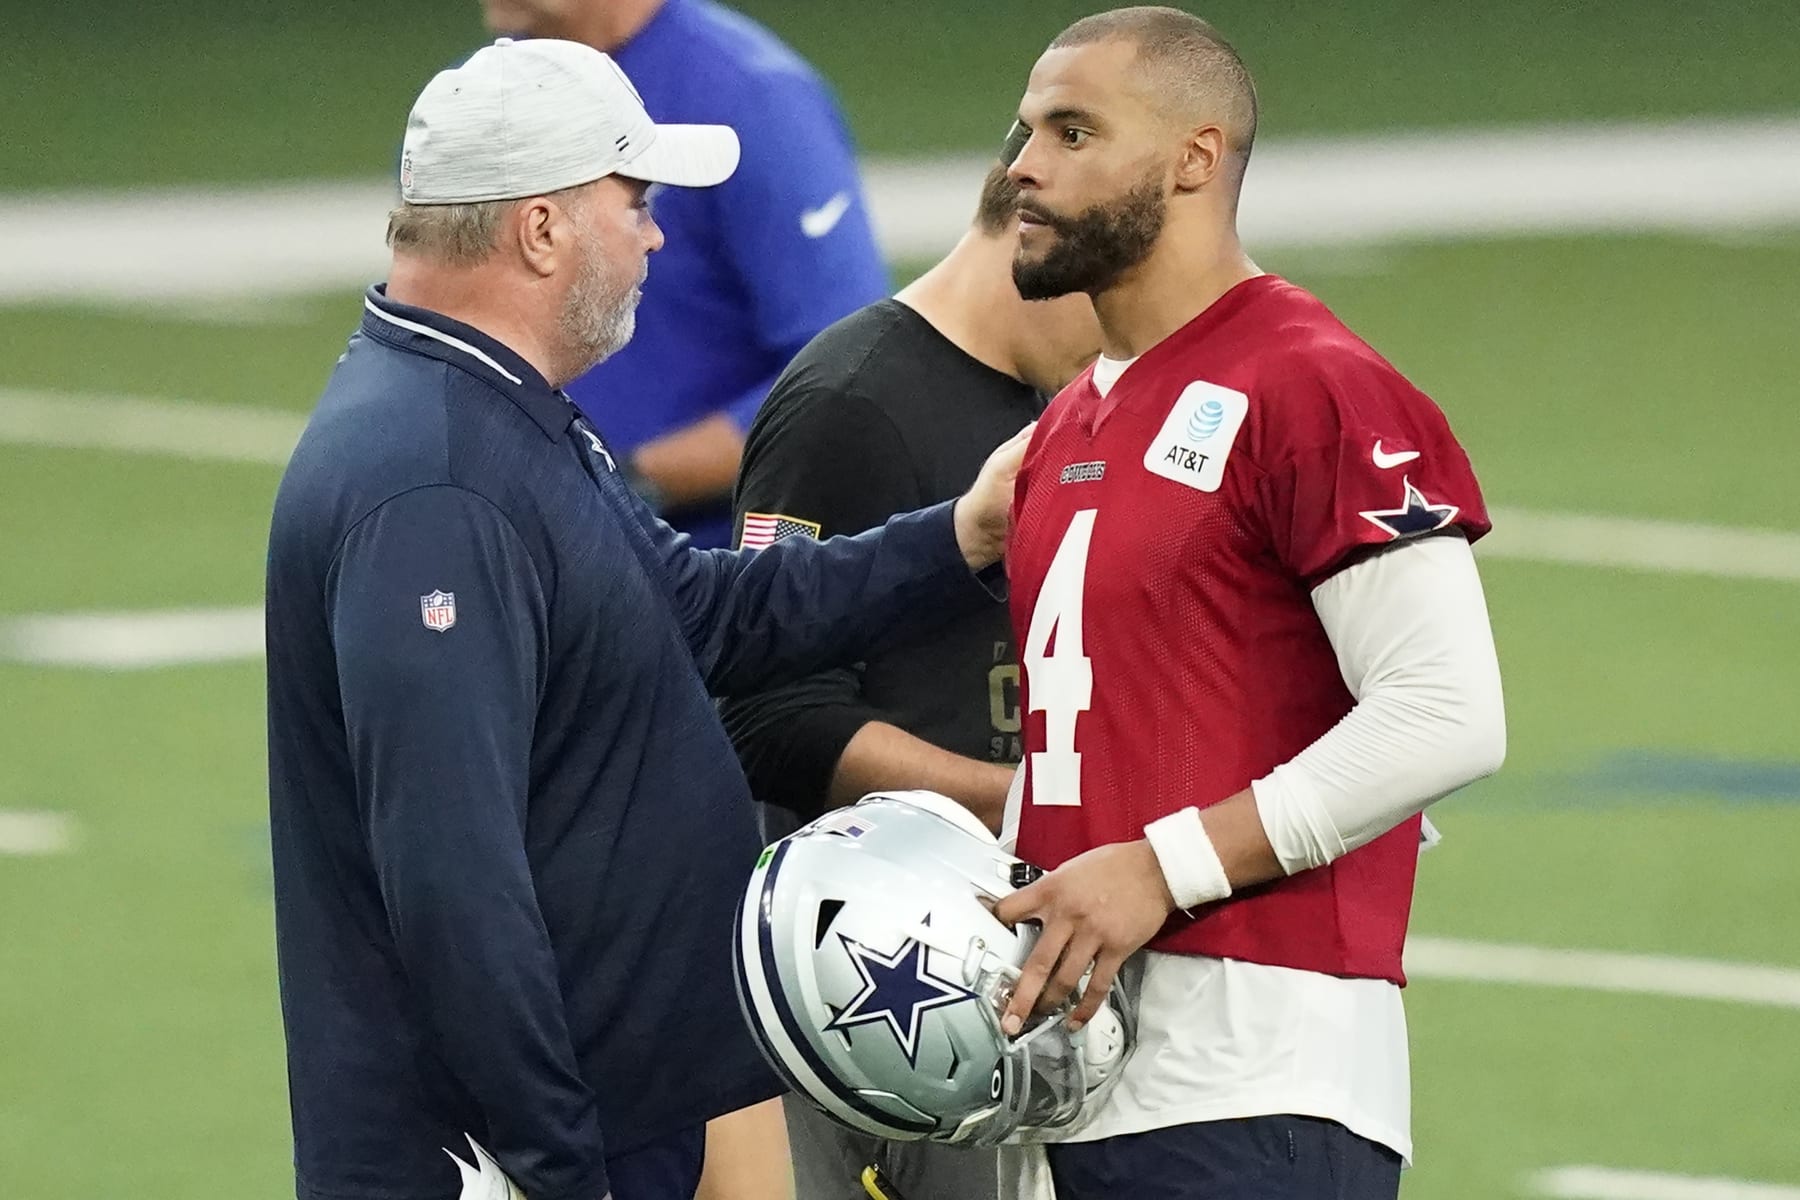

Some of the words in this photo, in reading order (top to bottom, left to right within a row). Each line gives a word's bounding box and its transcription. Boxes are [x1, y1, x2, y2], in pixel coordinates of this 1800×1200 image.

[1163, 444, 1209, 473] AT&T
[427, 607, 453, 626] NFL
[1023, 508, 1099, 807] 4
